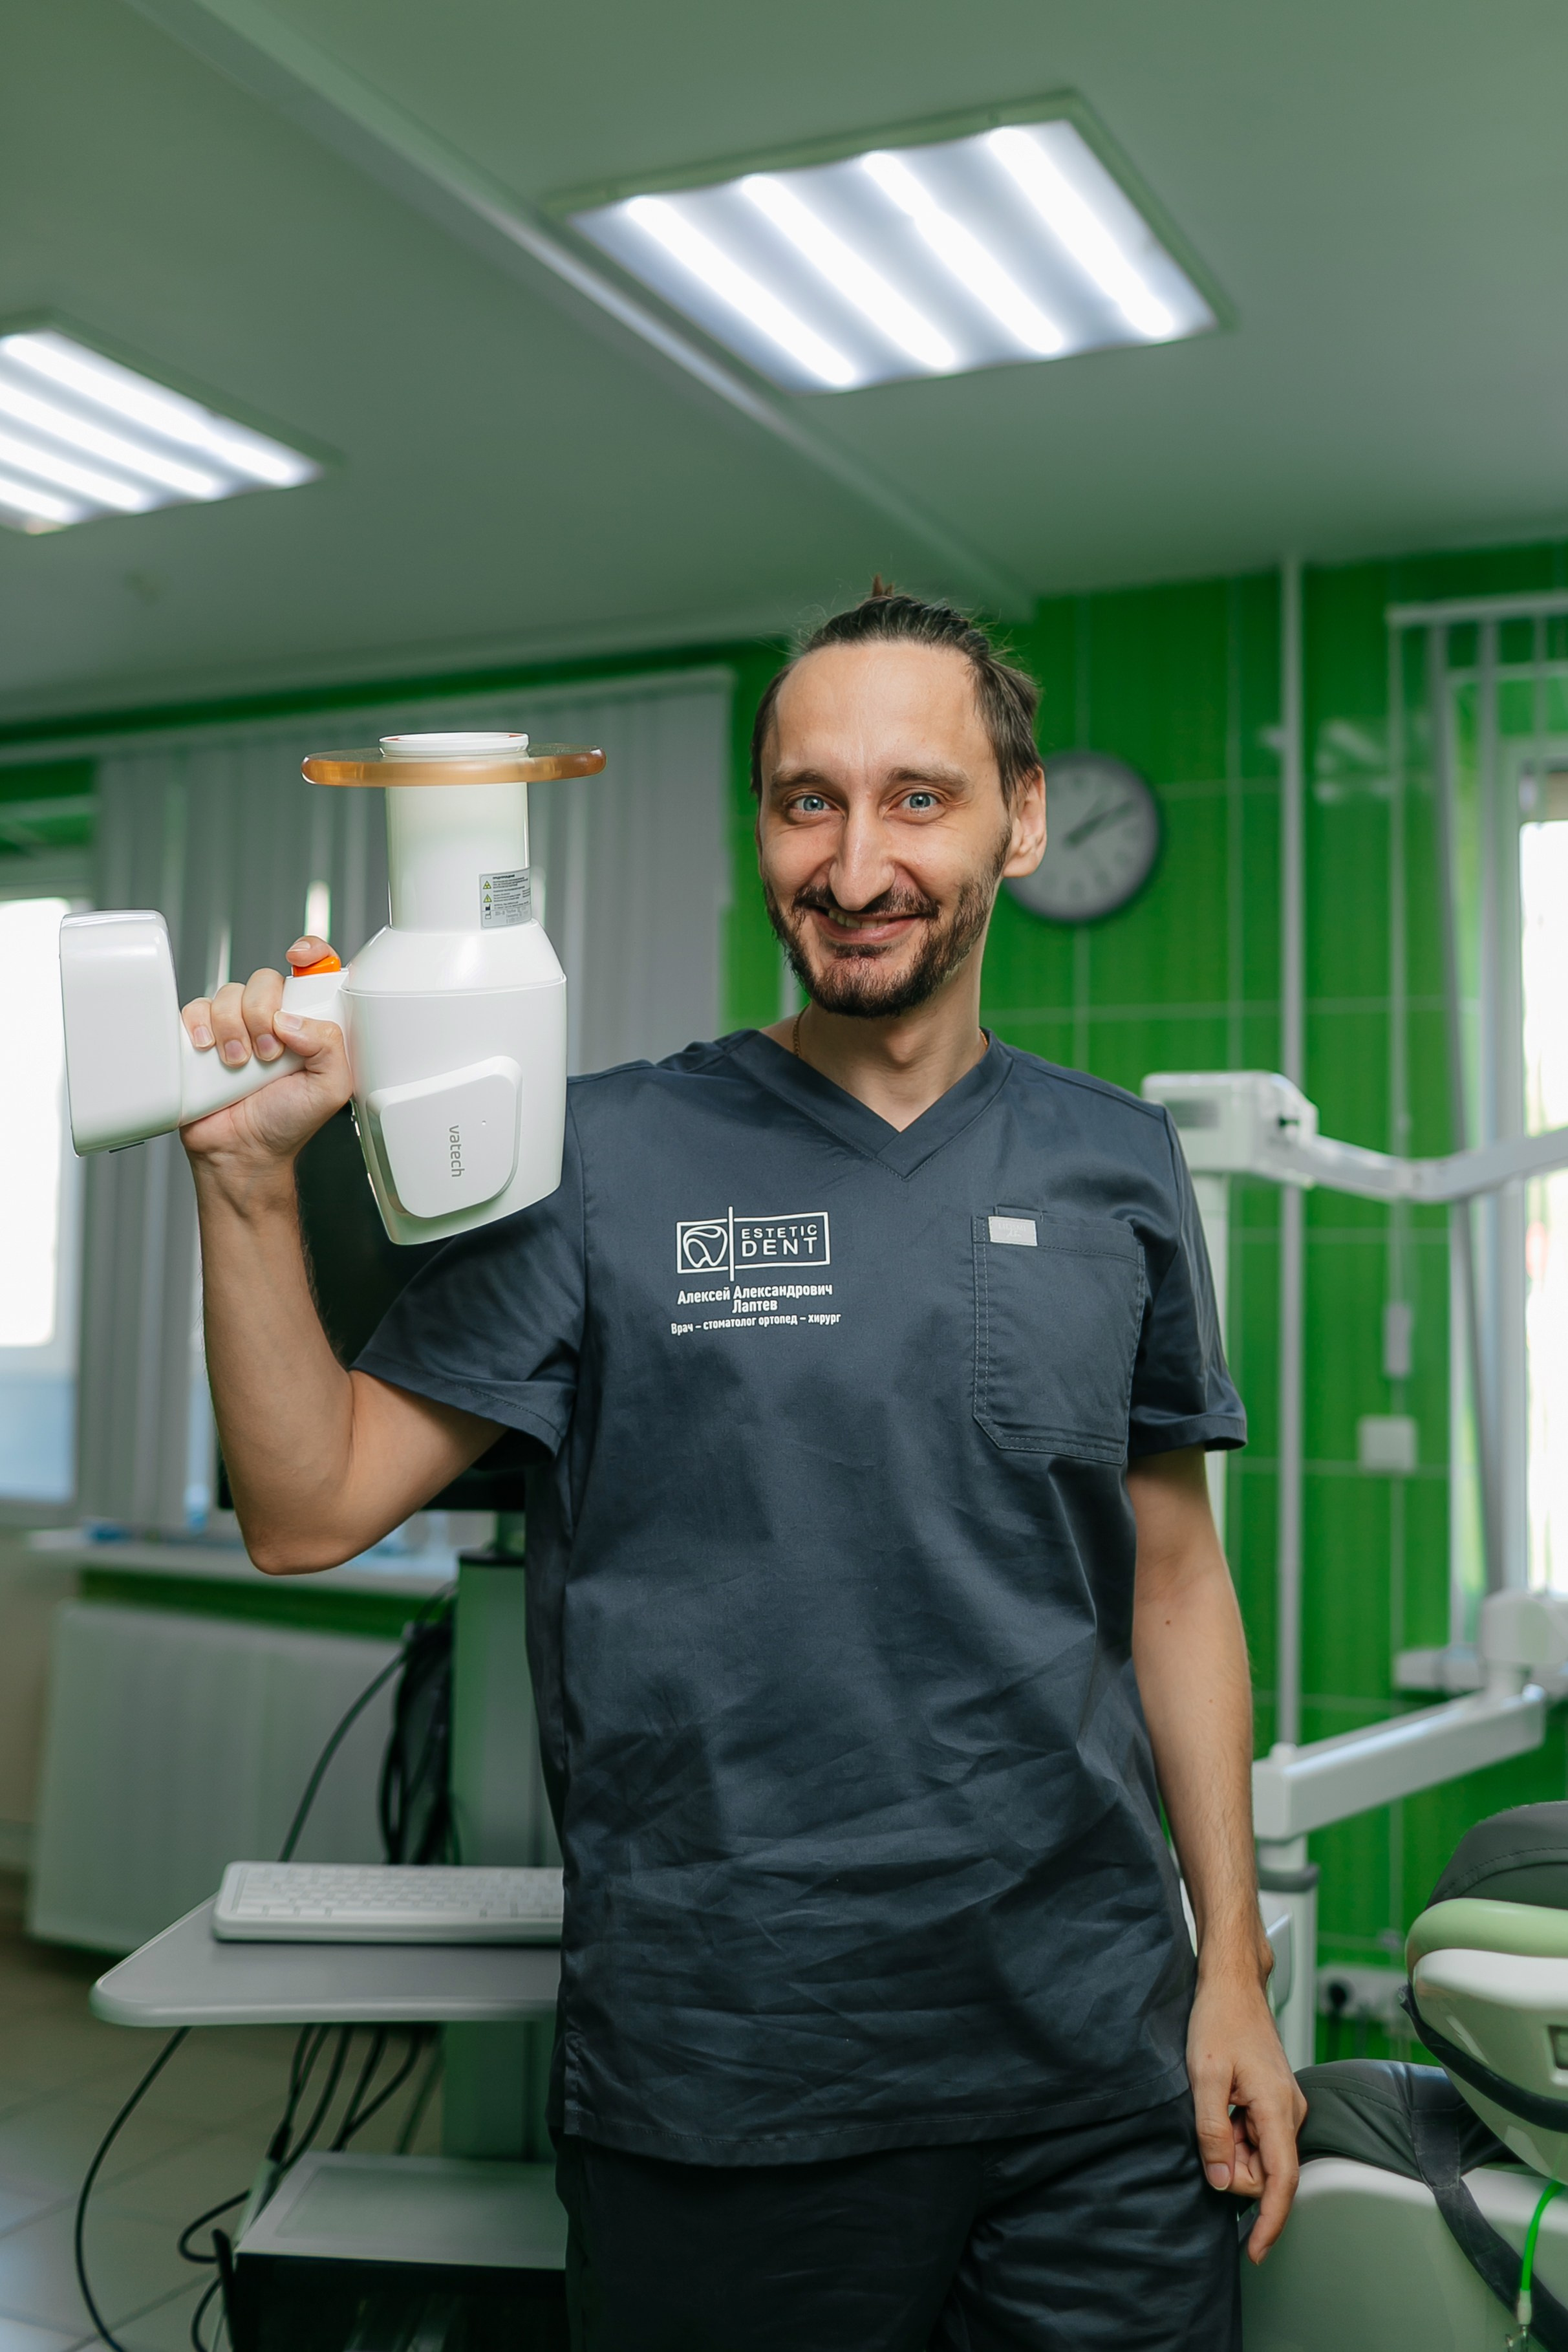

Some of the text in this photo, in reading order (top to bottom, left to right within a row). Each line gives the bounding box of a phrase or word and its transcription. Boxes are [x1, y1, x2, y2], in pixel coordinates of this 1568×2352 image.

[449, 1125, 465, 1177] vatech
[741, 1224, 817, 1239] ESTETIC
[742, 1236, 817, 1257] DENT
[677, 1284, 833, 1305] Алексей Александрович
[731, 1299, 778, 1314] Лаптев
[671, 1323, 694, 1336] Врач
[703, 1317, 757, 1330] стоматолог
[758, 1315, 798, 1328] ортопед
[808, 1314, 841, 1325] хирург
